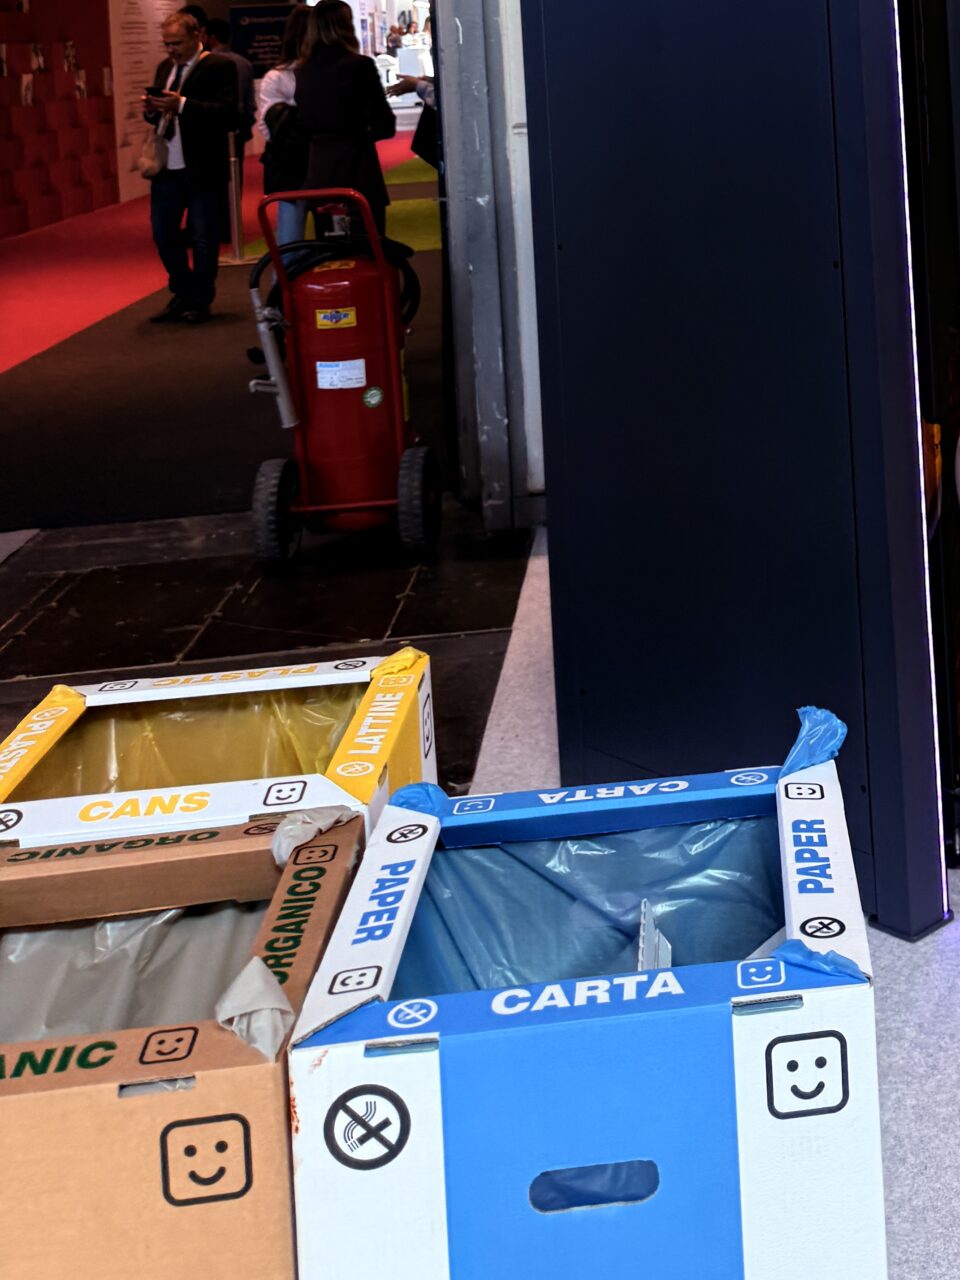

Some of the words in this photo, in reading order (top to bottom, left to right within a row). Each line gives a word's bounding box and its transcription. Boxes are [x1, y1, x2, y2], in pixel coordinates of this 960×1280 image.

[153, 665, 319, 687] PLASTIC
[348, 691, 404, 755] LATTINE
[78, 791, 210, 823] CANS
[537, 780, 690, 804] CARTA
[7, 830, 221, 863] ORGANIC
[791, 818, 835, 895] PAPER
[351, 858, 416, 946] PAPER
[490, 971, 685, 1016] CARTA
